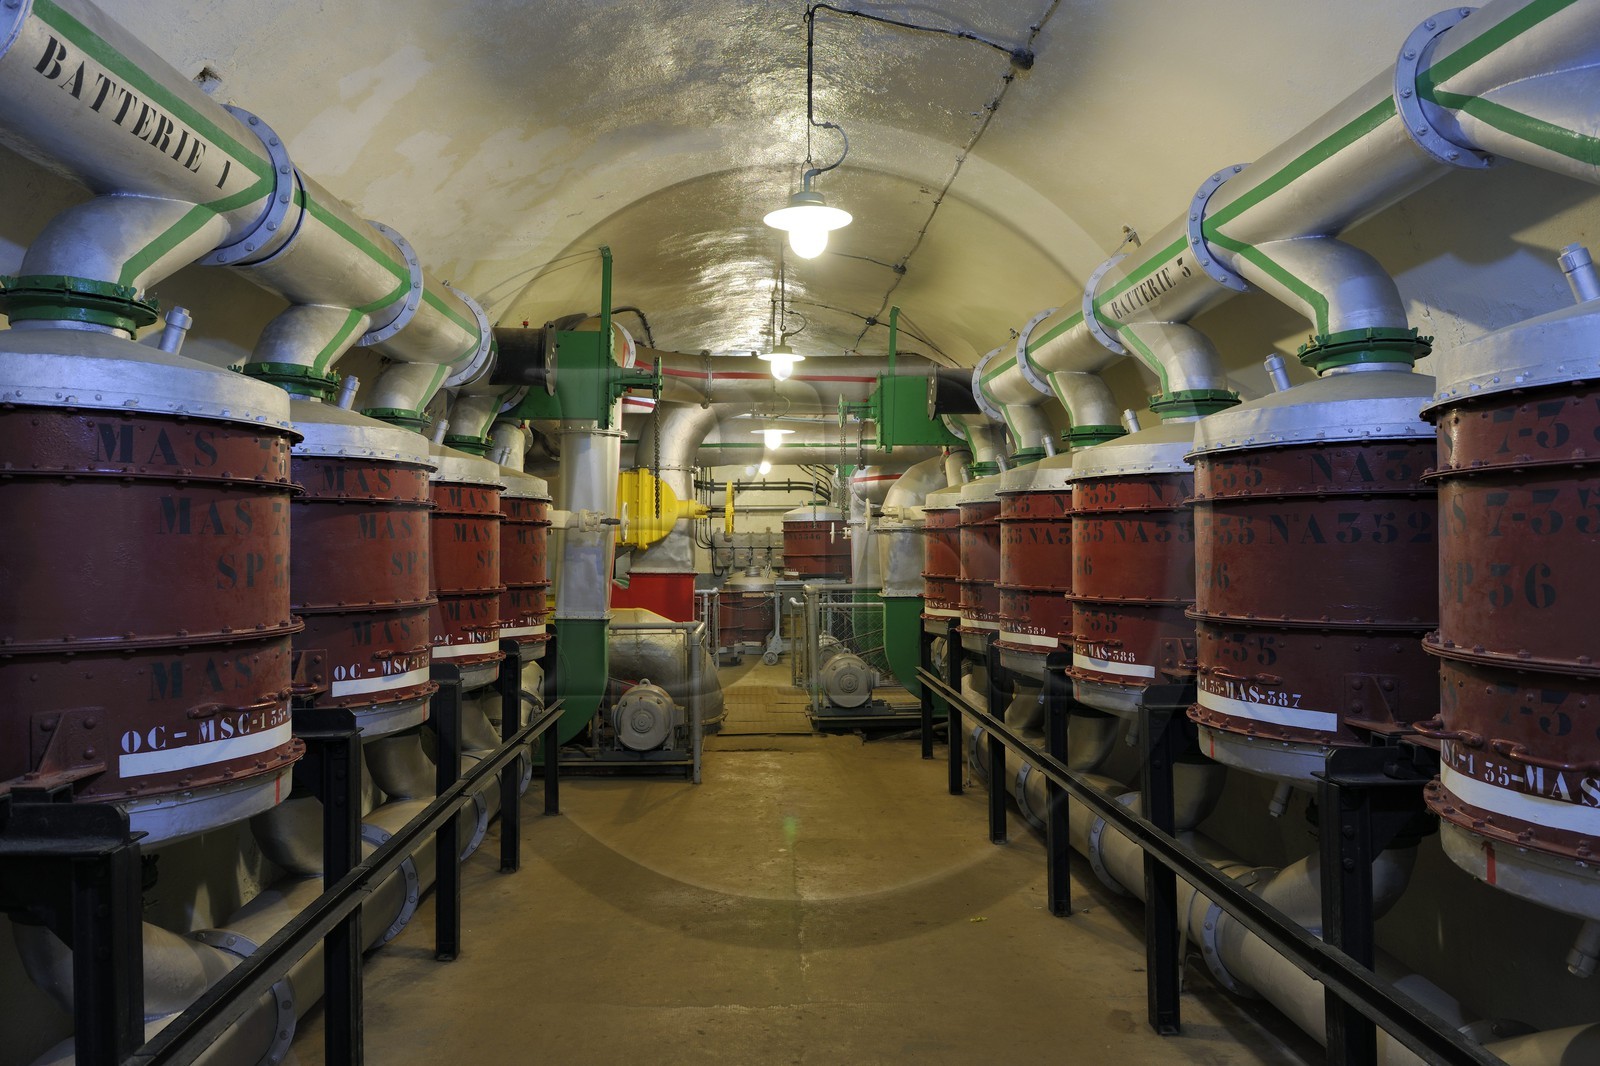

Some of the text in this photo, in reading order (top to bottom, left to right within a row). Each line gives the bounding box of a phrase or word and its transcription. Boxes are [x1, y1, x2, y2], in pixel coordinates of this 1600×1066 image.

[33, 35, 207, 174] BATTERIE
[1111, 267, 1177, 320] BATTERIE
[97, 423, 218, 467] MAS
[321, 464, 392, 493] MAS
[447, 487, 489, 508] MAS
[154, 496, 253, 536] MAS
[357, 512, 413, 540] MAS
[453, 522, 491, 543] MAS
[215, 552, 264, 589] SP
[391, 550, 418, 576] SP
[350, 618, 411, 648] MAS
[147, 653, 254, 700] MAS
